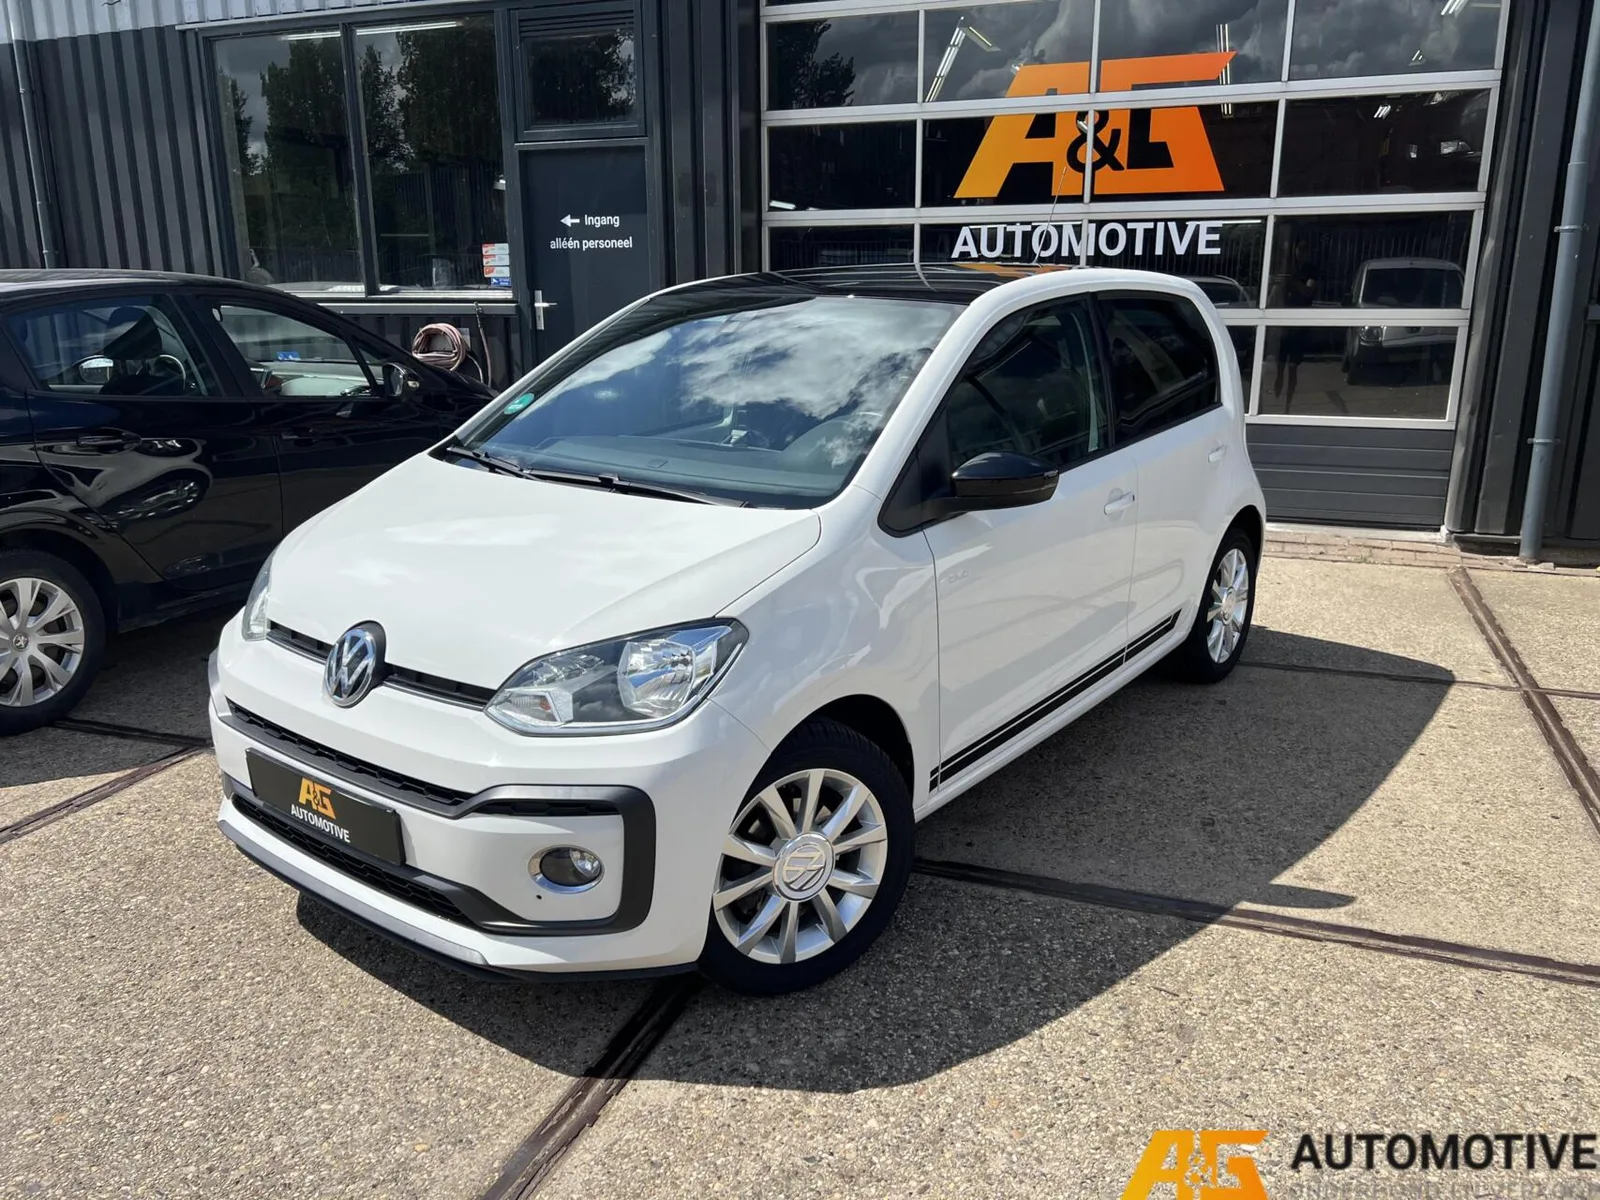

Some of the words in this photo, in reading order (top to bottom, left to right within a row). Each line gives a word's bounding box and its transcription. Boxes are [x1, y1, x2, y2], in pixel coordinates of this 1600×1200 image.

[584, 214, 620, 228] Ingang
[550, 237, 580, 250] alléén
[582, 236, 633, 252] personeel
[951, 220, 1223, 258] AUTOMOTIVE
[291, 804, 351, 843] AUTOMOTIVE
